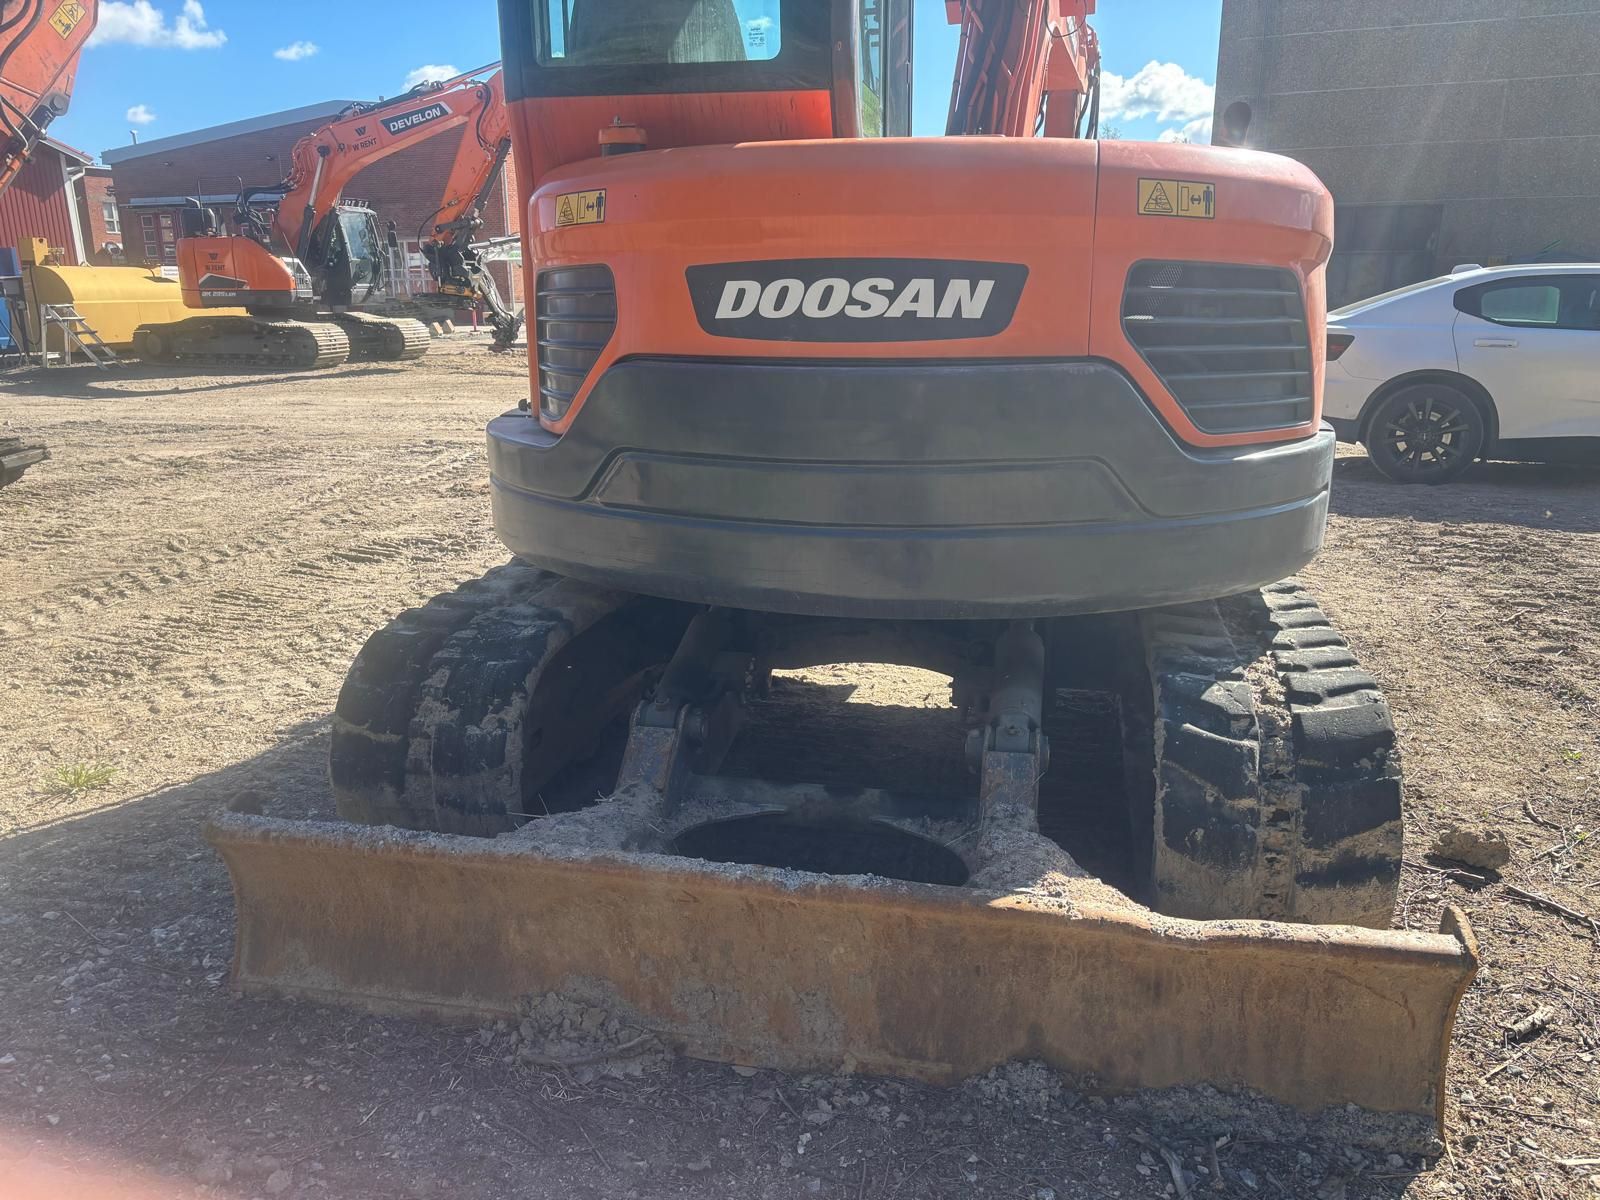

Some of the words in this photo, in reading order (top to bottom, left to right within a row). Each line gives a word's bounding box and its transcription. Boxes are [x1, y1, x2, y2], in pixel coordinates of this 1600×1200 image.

[389, 107, 441, 132] DEVELON
[352, 143, 359, 151] W
[360, 138, 377, 148] RENT
[714, 277, 996, 319] DOOSAN
